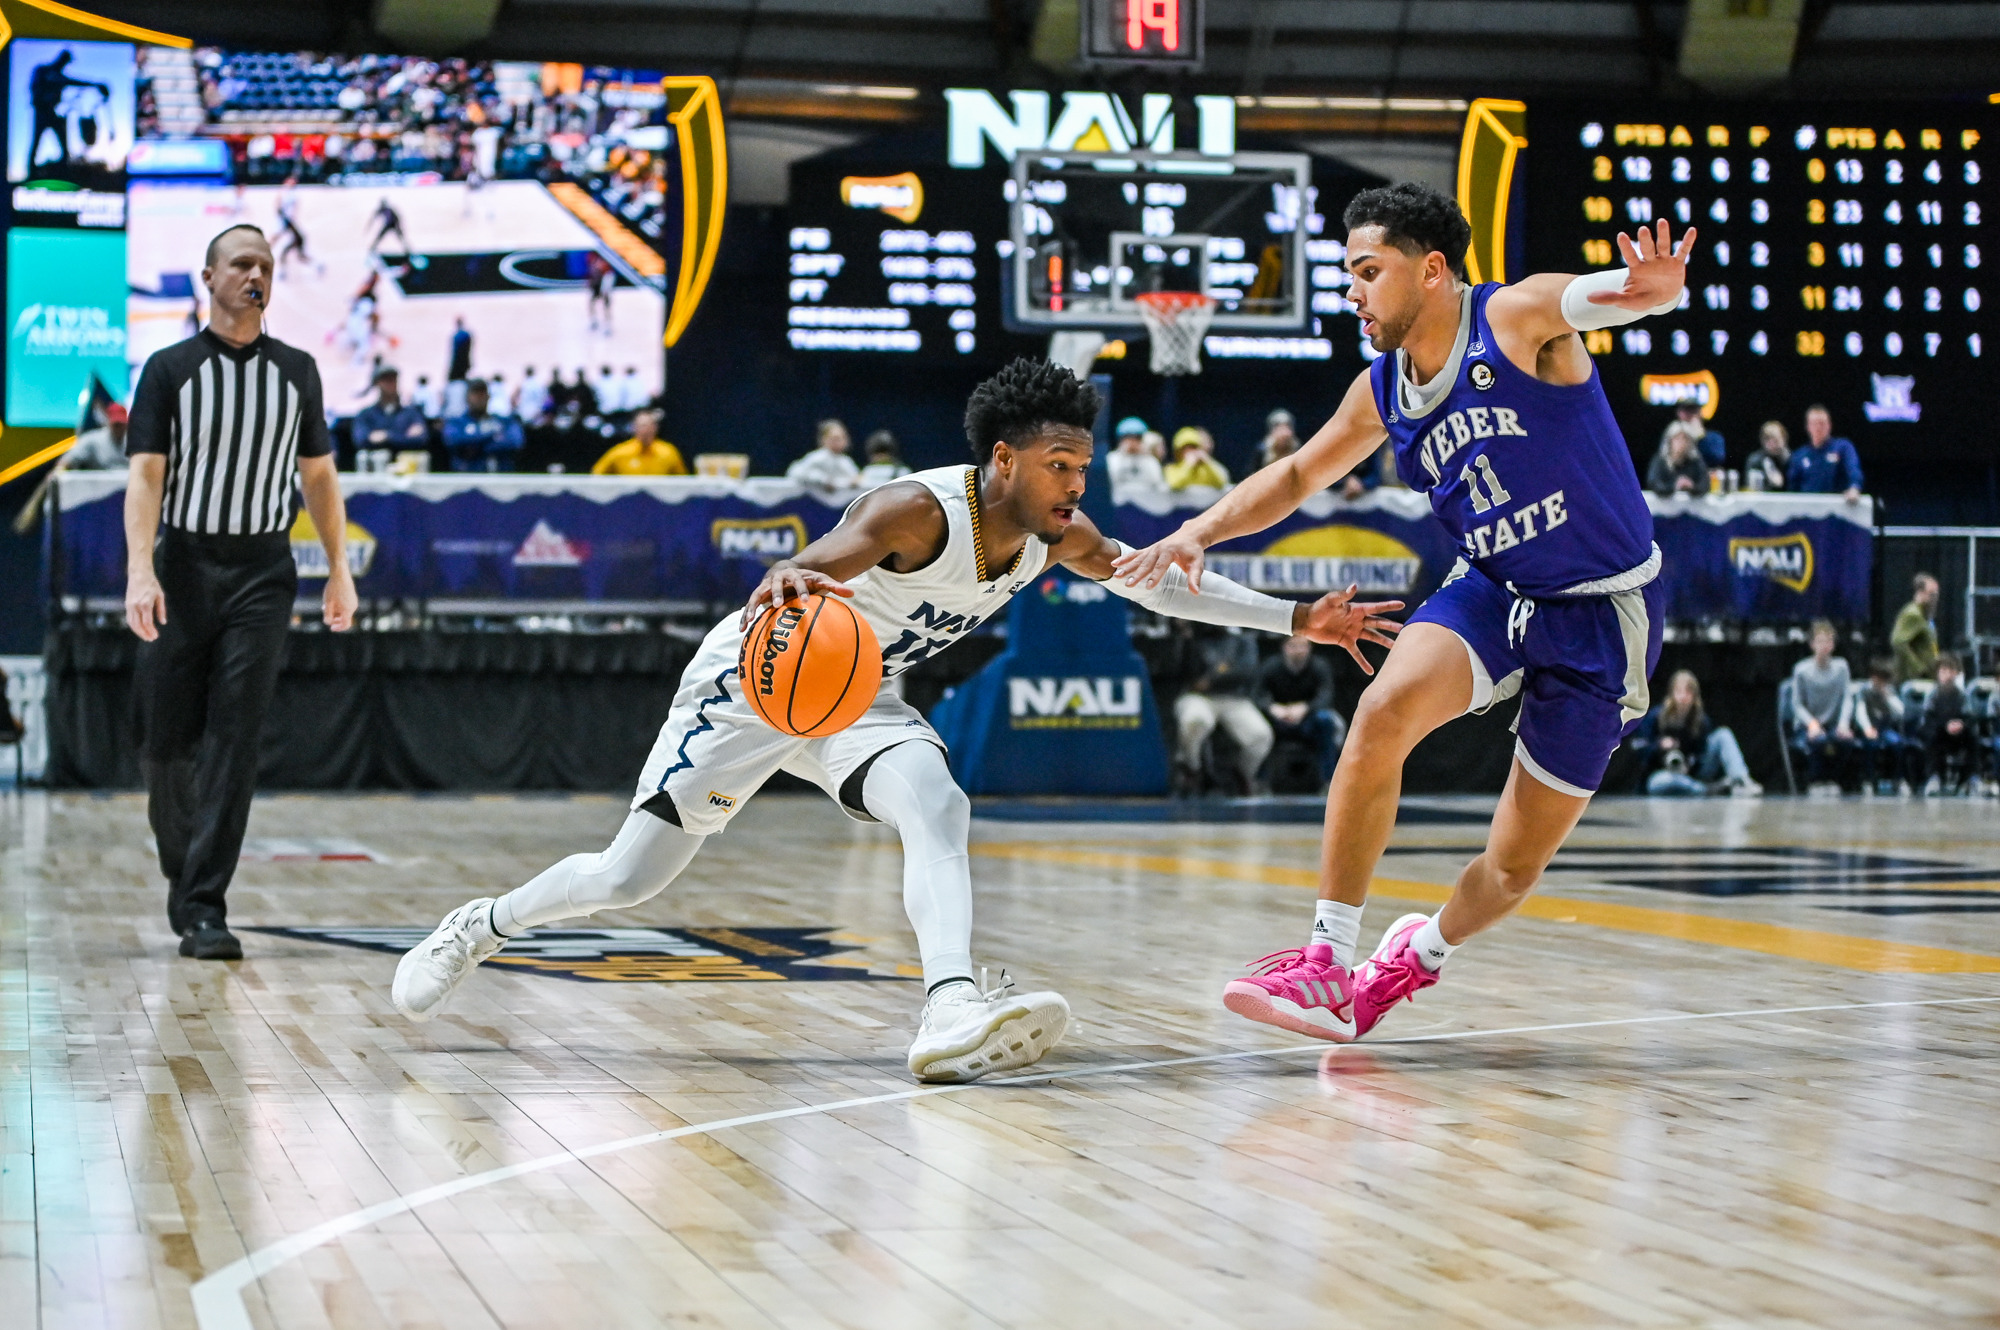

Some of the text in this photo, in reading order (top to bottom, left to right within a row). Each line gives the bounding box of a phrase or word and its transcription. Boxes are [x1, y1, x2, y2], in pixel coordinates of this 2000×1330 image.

[943, 88, 1236, 175] NAU
[1671, 125, 1692, 146] A
[1884, 129, 1905, 149] A
[1594, 156, 1612, 180] 2
[1622, 157, 1651, 181] 12
[1672, 157, 1691, 182] 2
[1752, 158, 1770, 183] 2
[1835, 159, 1863, 183] 13
[1886, 160, 1903, 184] 2
[1924, 160, 1941, 184] 4
[1964, 161, 1980, 184] 3
[1626, 198, 1651, 222] 11
[1675, 198, 1690, 222] 1
[1710, 198, 1729, 223] 4
[1834, 200, 1863, 224] 23
[1884, 200, 1902, 224] 4
[1918, 201, 1941, 225] 11
[1964, 201, 1980, 225] 2
[1715, 241, 1729, 266] 1
[1751, 242, 1769, 266] 2
[1839, 243, 1863, 267] 11
[1928, 244, 1941, 267] 1
[1964, 244, 1980, 268] 3
[1704, 285, 1729, 309] 11
[1801, 286, 1825, 309] 11
[1884, 287, 1902, 310] 4
[1924, 287, 1941, 311] 2
[1964, 288, 1980, 312] 0
[1711, 330, 1729, 355] 7
[1885, 332, 1902, 356] 0
[1925, 333, 1941, 356] 7
[1968, 333, 1981, 357] 1
[1420, 406, 1528, 488] WEBER
[1459, 453, 1512, 514] 11
[1464, 490, 1568, 559] STATE
[721, 529, 795, 554] NAU
[1737, 547, 1803, 572] NAU
[760, 606, 809, 696] Wilson
[1009, 677, 1142, 716] NAU
[709, 795, 733, 808] NAU
